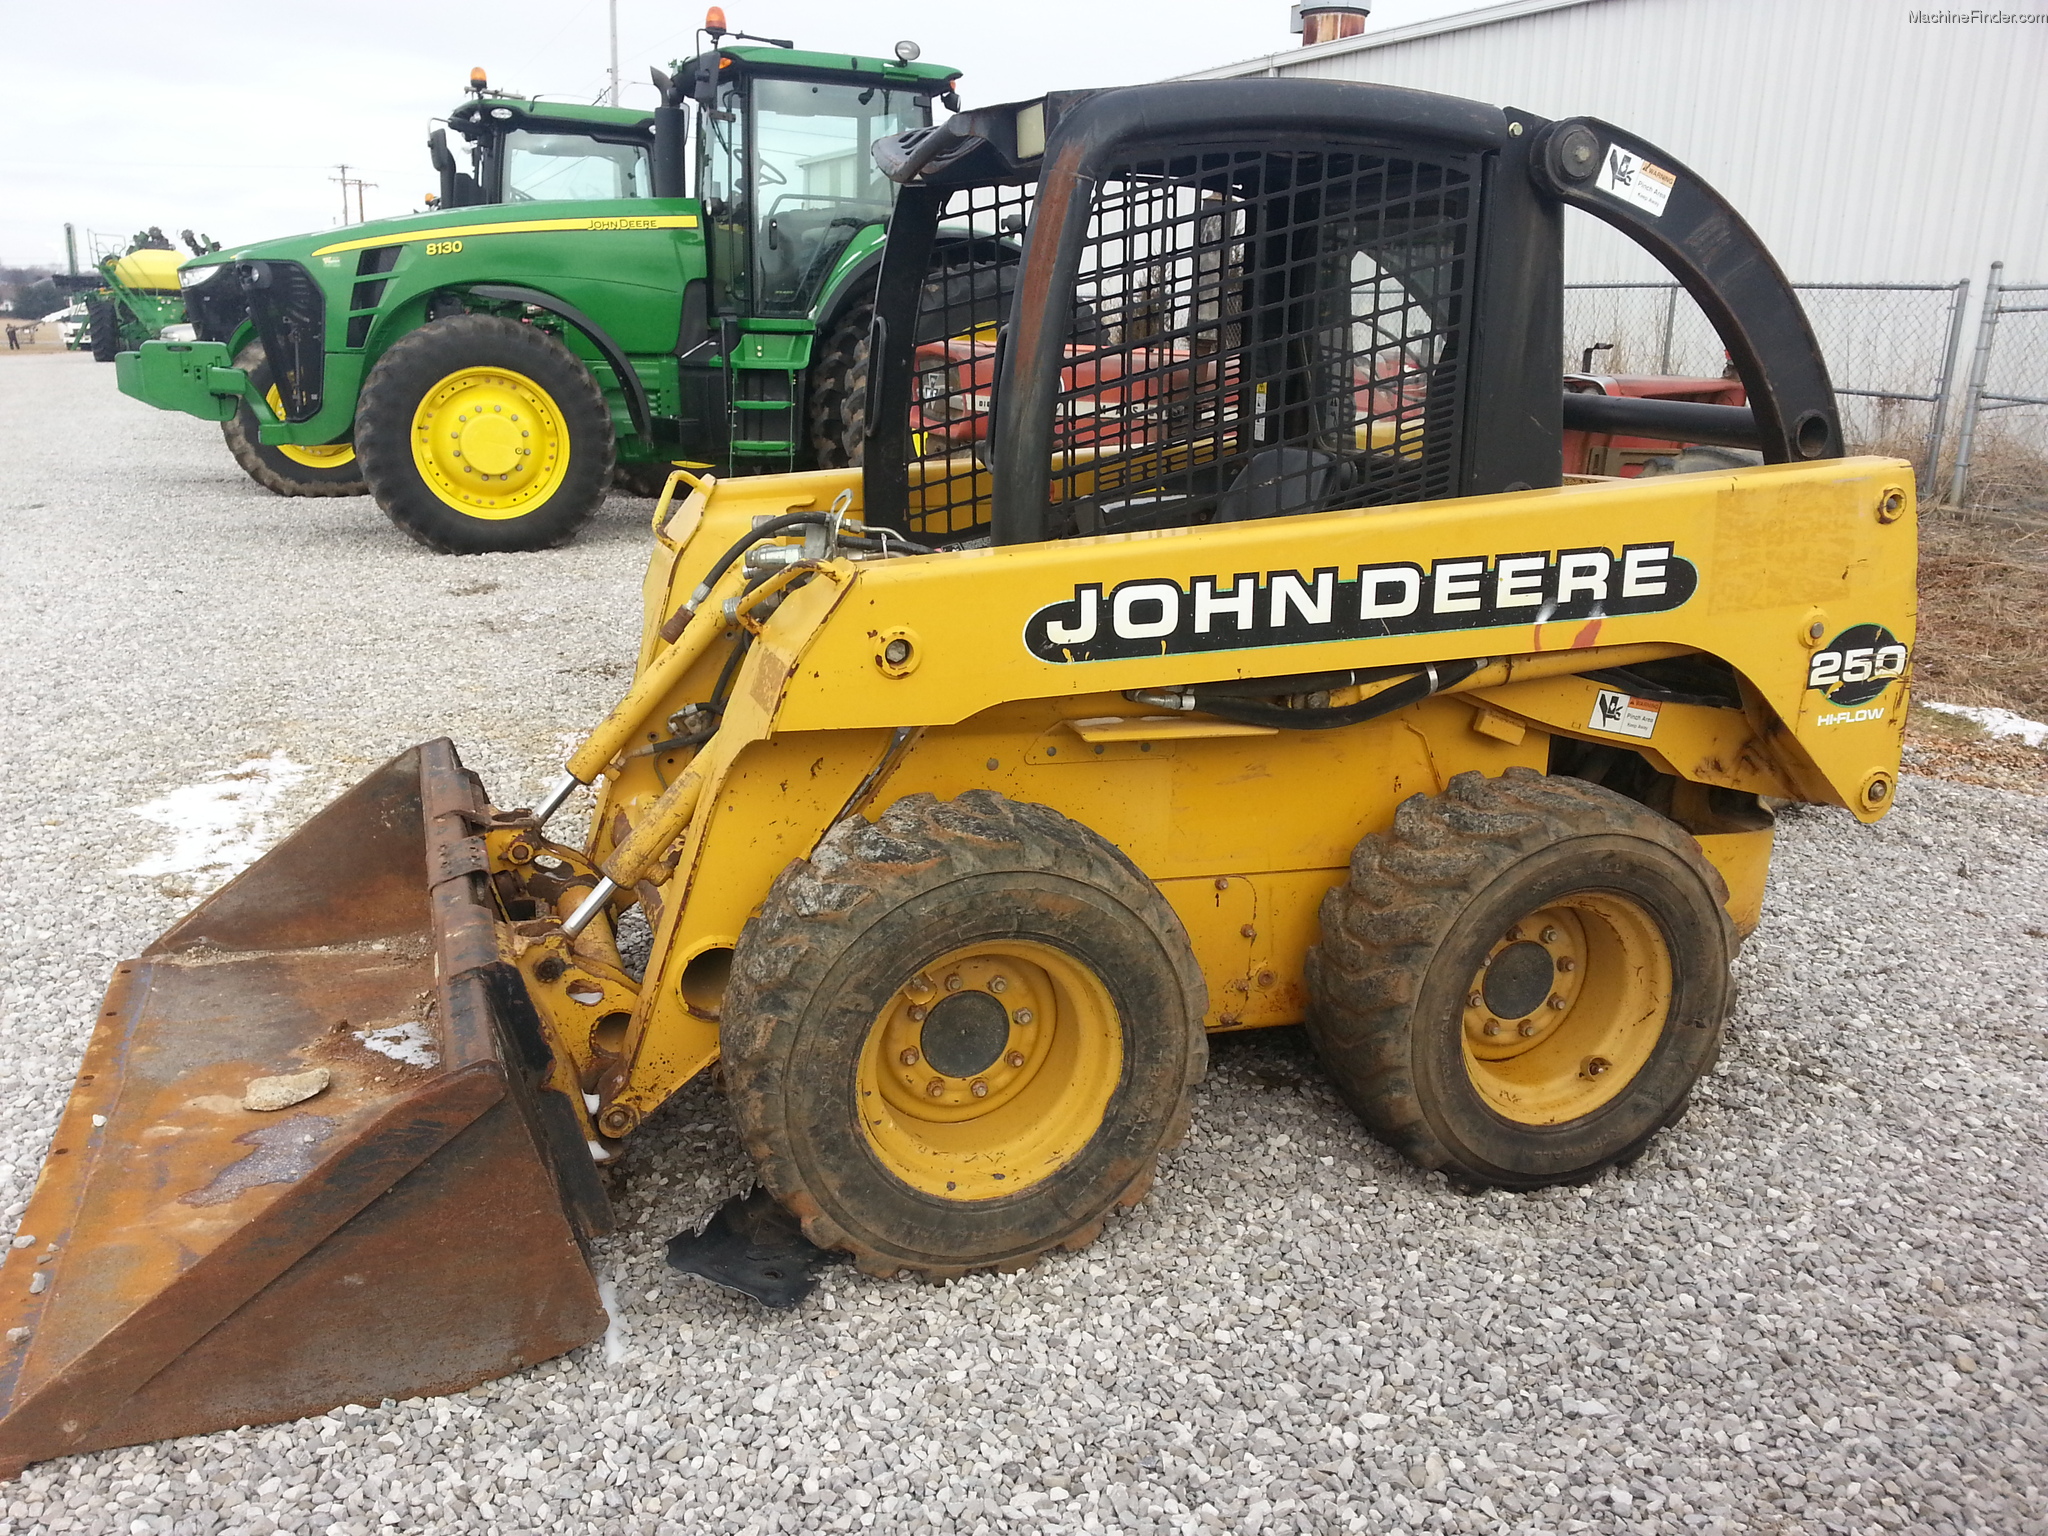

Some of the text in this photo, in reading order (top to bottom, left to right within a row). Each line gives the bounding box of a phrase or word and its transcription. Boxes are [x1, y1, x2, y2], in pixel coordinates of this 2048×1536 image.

[1649, 168, 1674, 185] WARNING
[588, 218, 657, 229] JOHN DEERE
[425, 240, 463, 256] 8130
[1045, 547, 1670, 646] JOHN DEERE
[1808, 644, 1908, 688] 250
[1816, 707, 1885, 727] HI-FLOW
